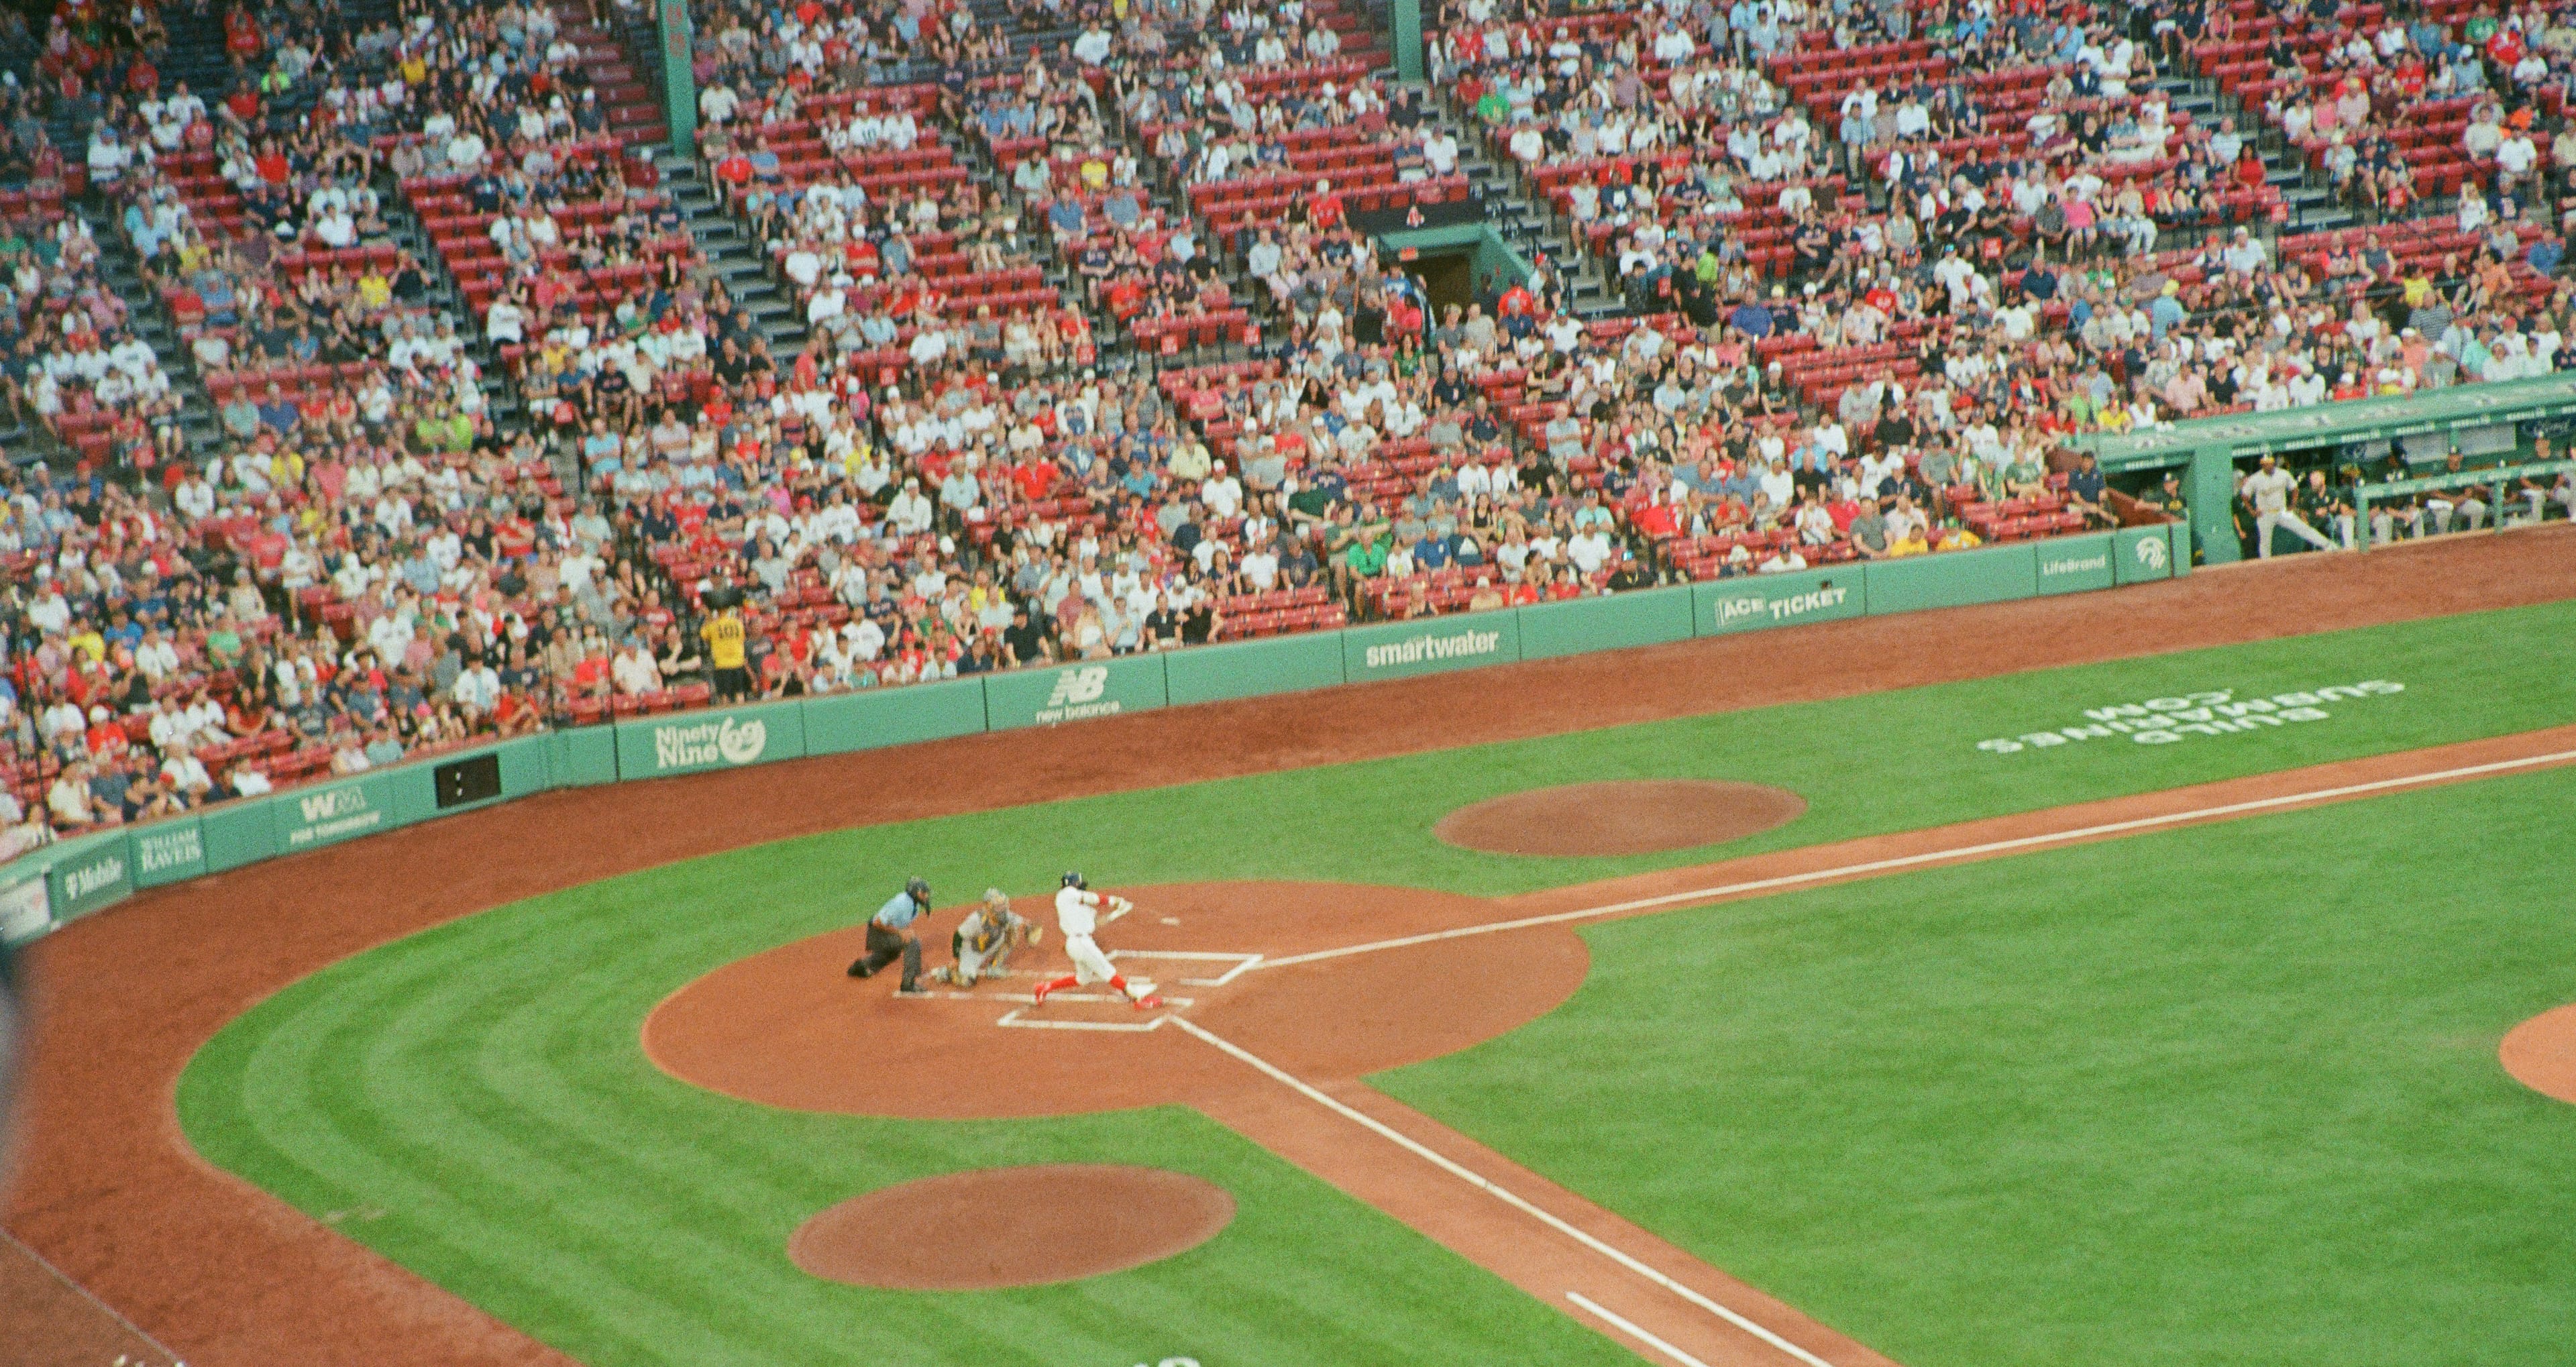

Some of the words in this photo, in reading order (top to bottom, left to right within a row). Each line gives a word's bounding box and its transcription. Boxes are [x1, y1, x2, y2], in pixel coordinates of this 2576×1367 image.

[1723, 597, 1765, 620] ACE
[1769, 587, 1847, 620] TICKET
[1366, 628, 1499, 668] smartwater
[1047, 666, 1108, 706] NB
[657, 743, 719, 769] Nine
